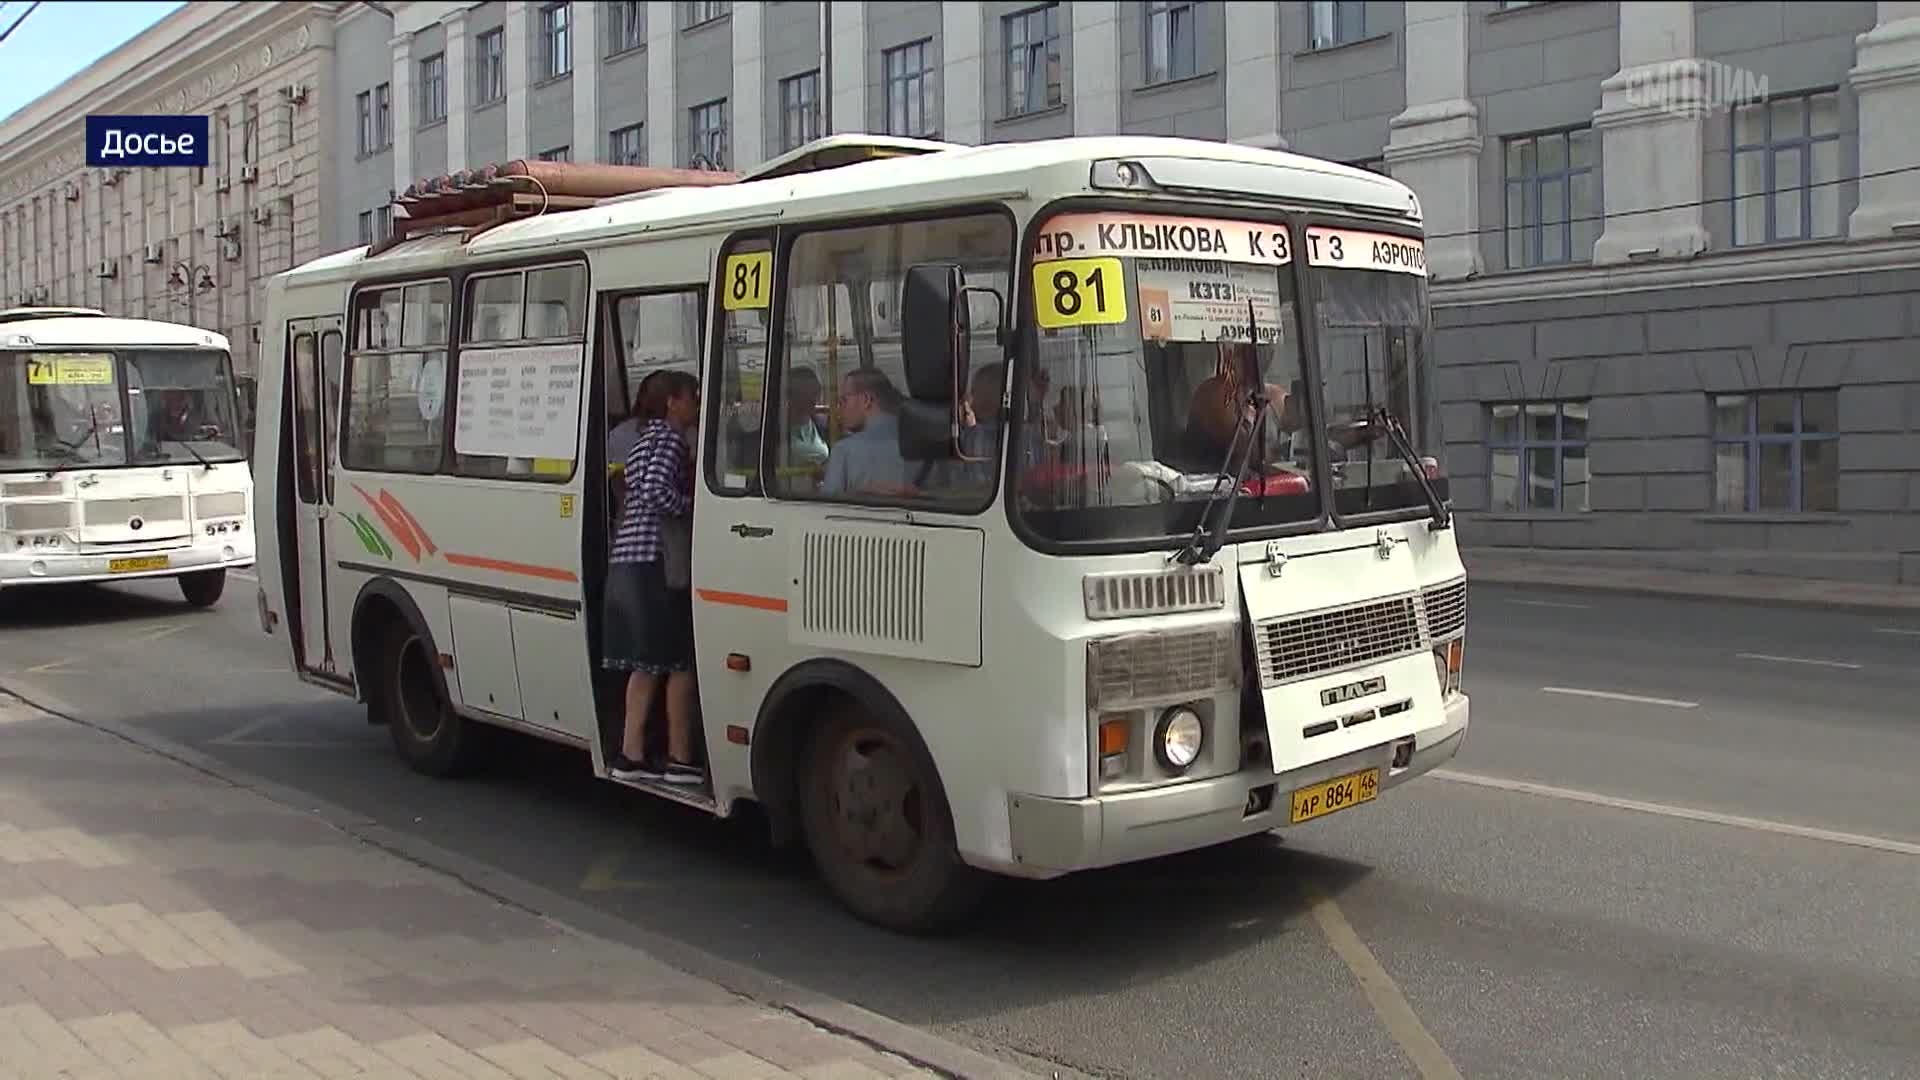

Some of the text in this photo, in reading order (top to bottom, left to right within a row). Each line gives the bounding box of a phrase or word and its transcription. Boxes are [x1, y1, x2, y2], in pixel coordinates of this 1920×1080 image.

[1033, 231, 1085, 257] пр.
[1097, 223, 1228, 253] КЛЫКОВА
[734, 260, 761, 300] 81
[1053, 267, 1106, 316] 81
[1189, 281, 1232, 300] КЗТЗ
[1150, 307, 1161, 322] 81
[1301, 795, 1320, 817] АР
[1326, 781, 1353, 809] 884
